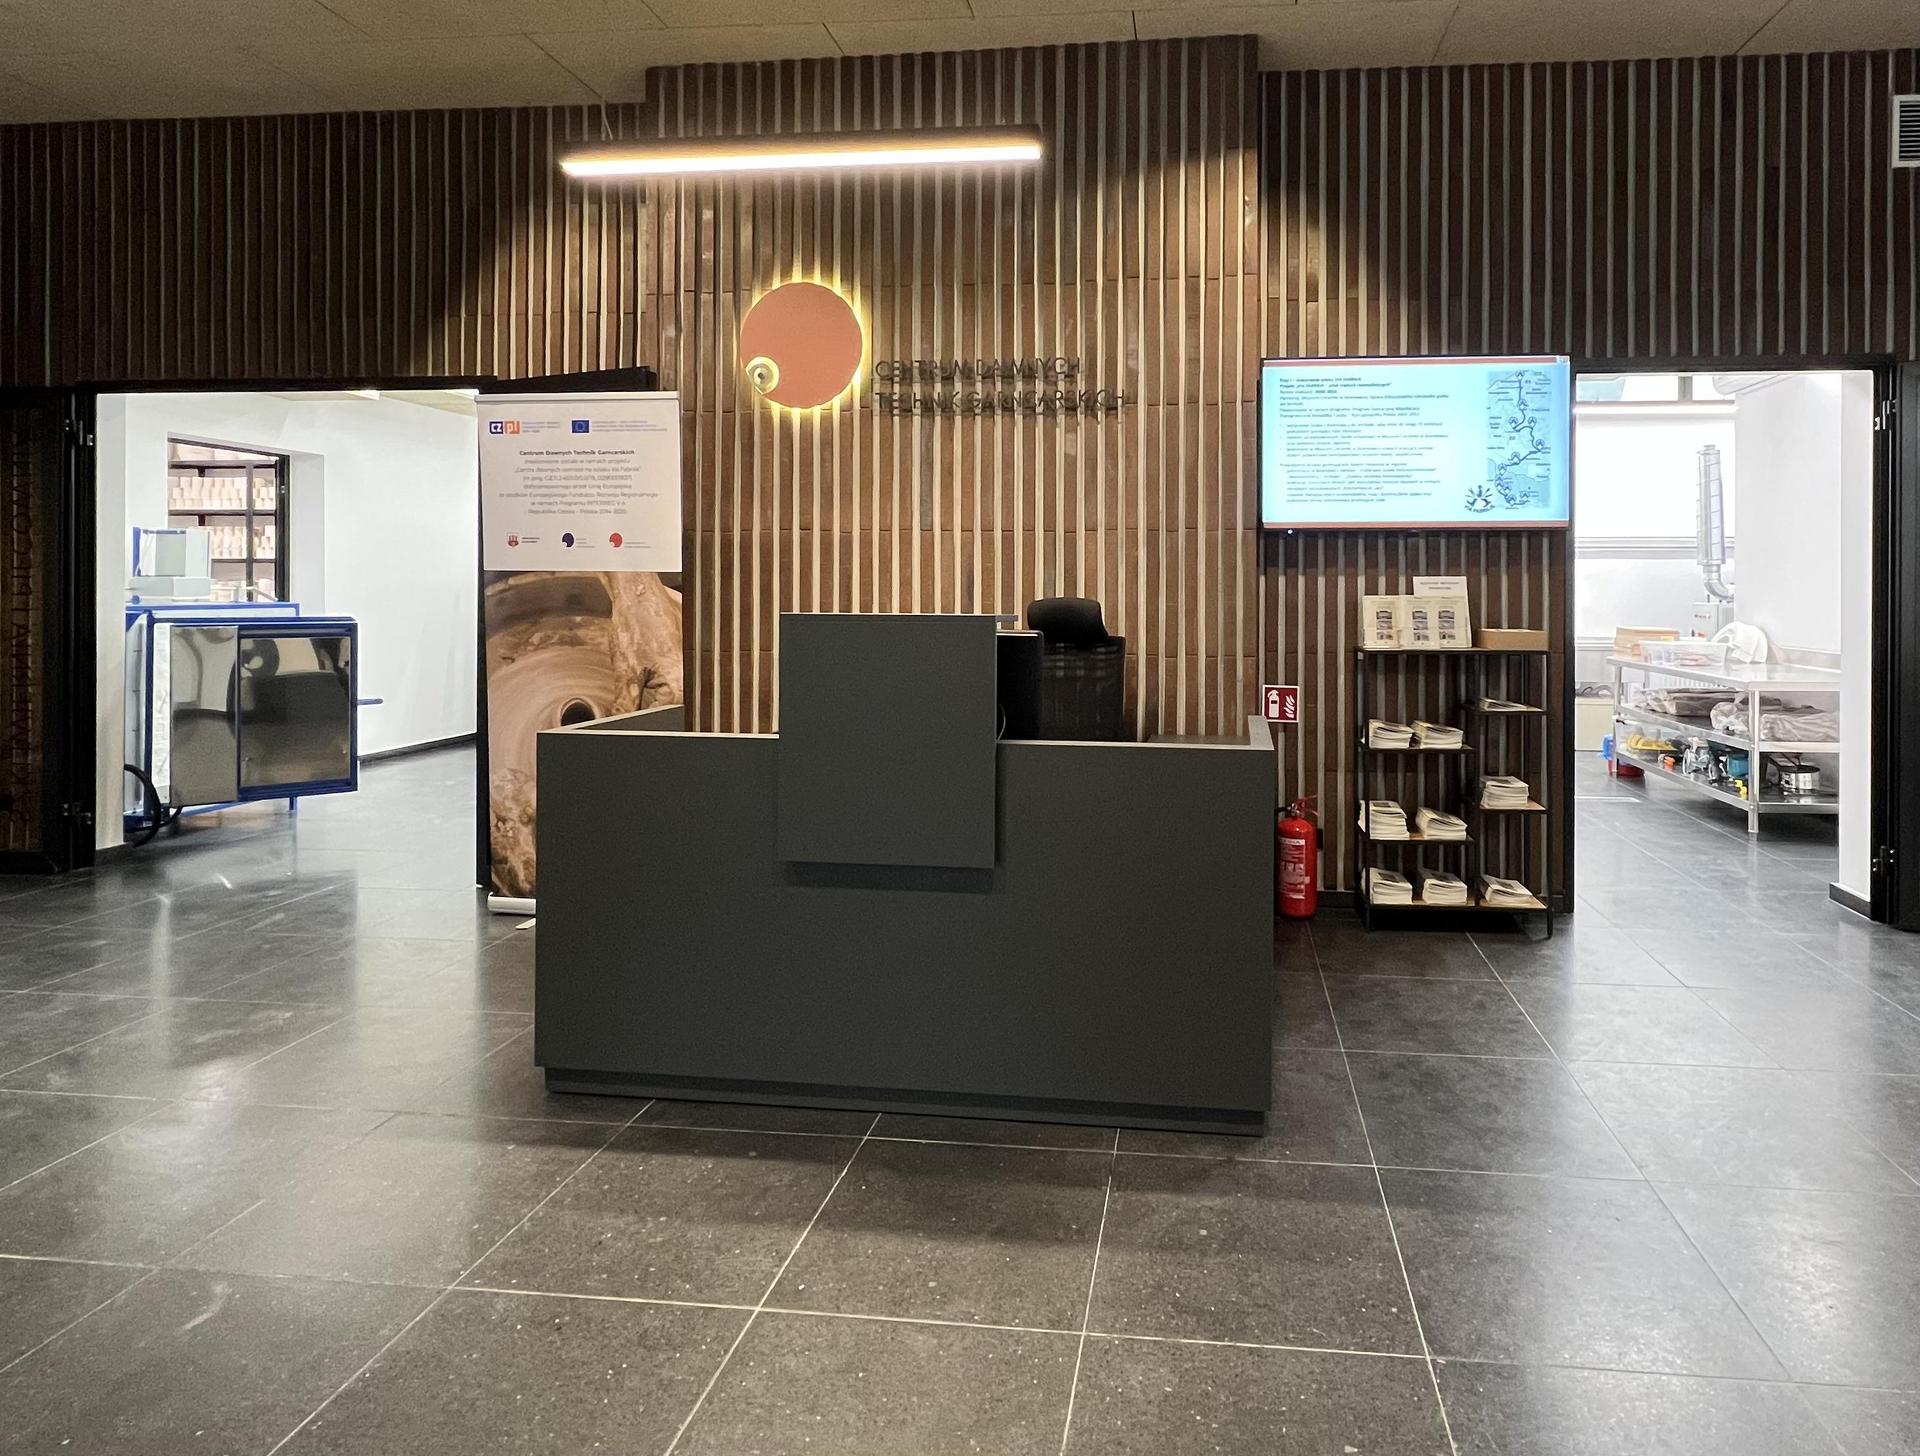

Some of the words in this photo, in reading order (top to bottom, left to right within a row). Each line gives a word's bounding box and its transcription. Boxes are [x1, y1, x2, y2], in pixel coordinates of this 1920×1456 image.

[875, 359, 969, 379] CENTRUM
[976, 357, 1081, 378] DAWNYCH
[874, 391, 960, 410] TECHNIK
